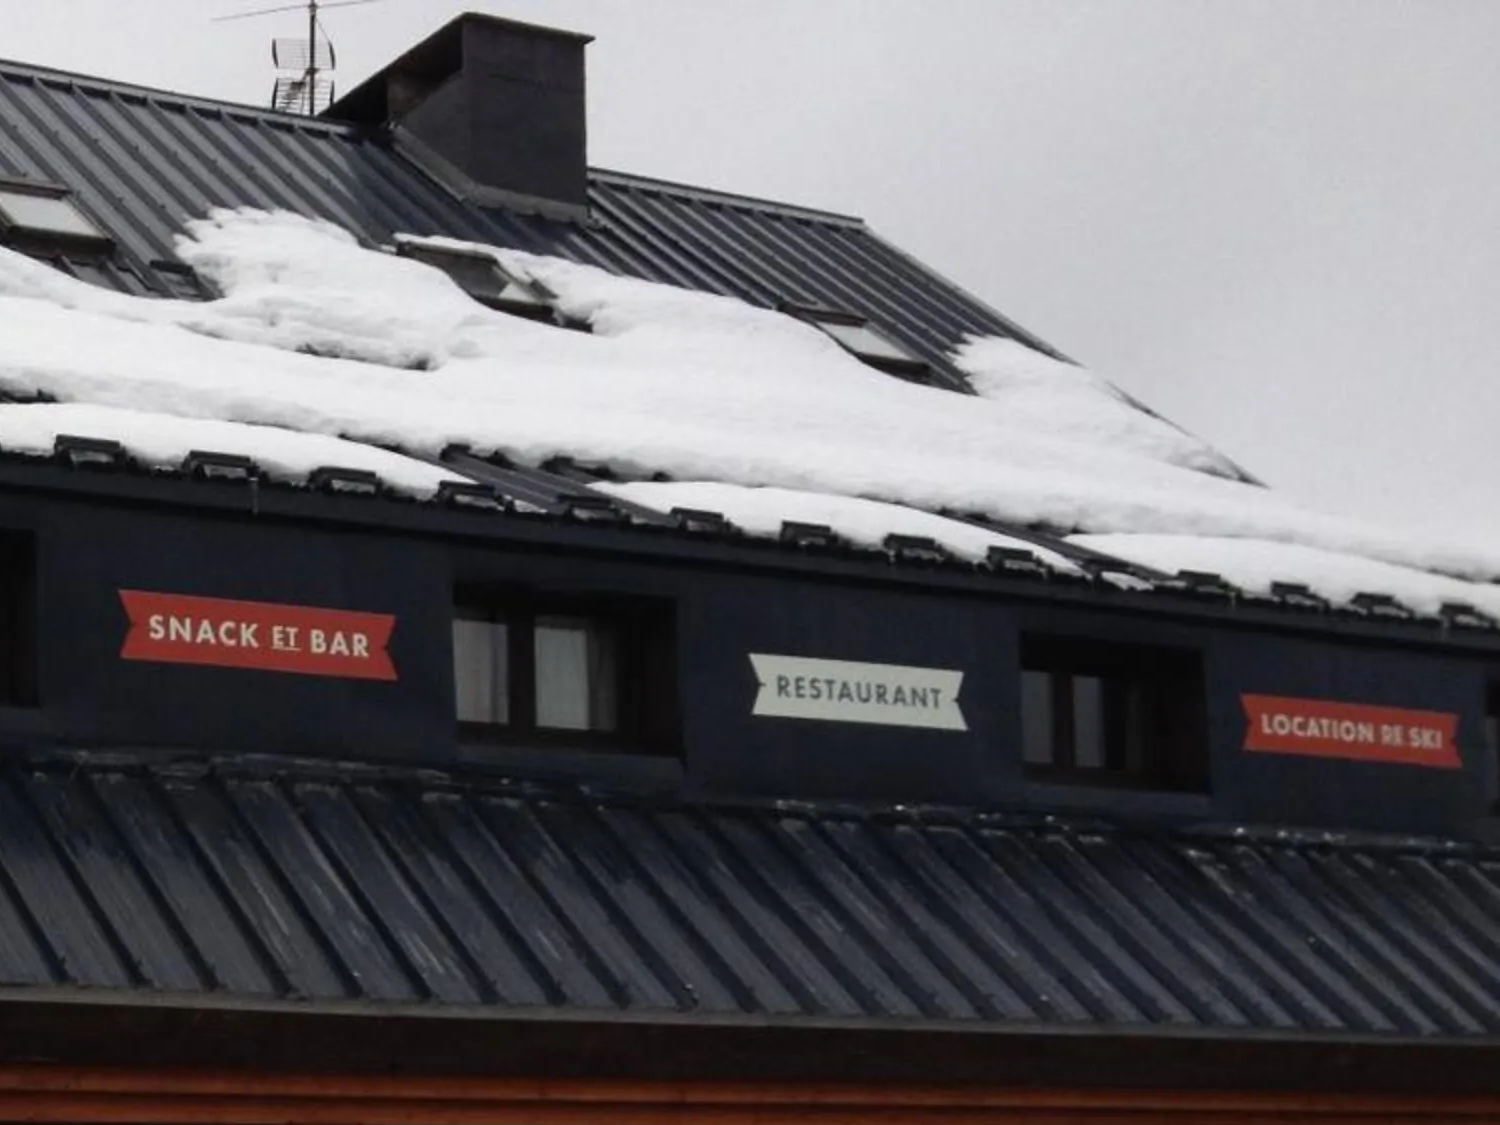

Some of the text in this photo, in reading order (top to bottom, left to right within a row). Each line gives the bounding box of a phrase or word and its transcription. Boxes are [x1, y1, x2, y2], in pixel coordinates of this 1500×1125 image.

[148, 613, 370, 659] SNACK ET BAR
[775, 674, 943, 711] RESTAURANT
[1260, 711, 1377, 744] LOCATION
[1407, 725, 1444, 750] SKI
